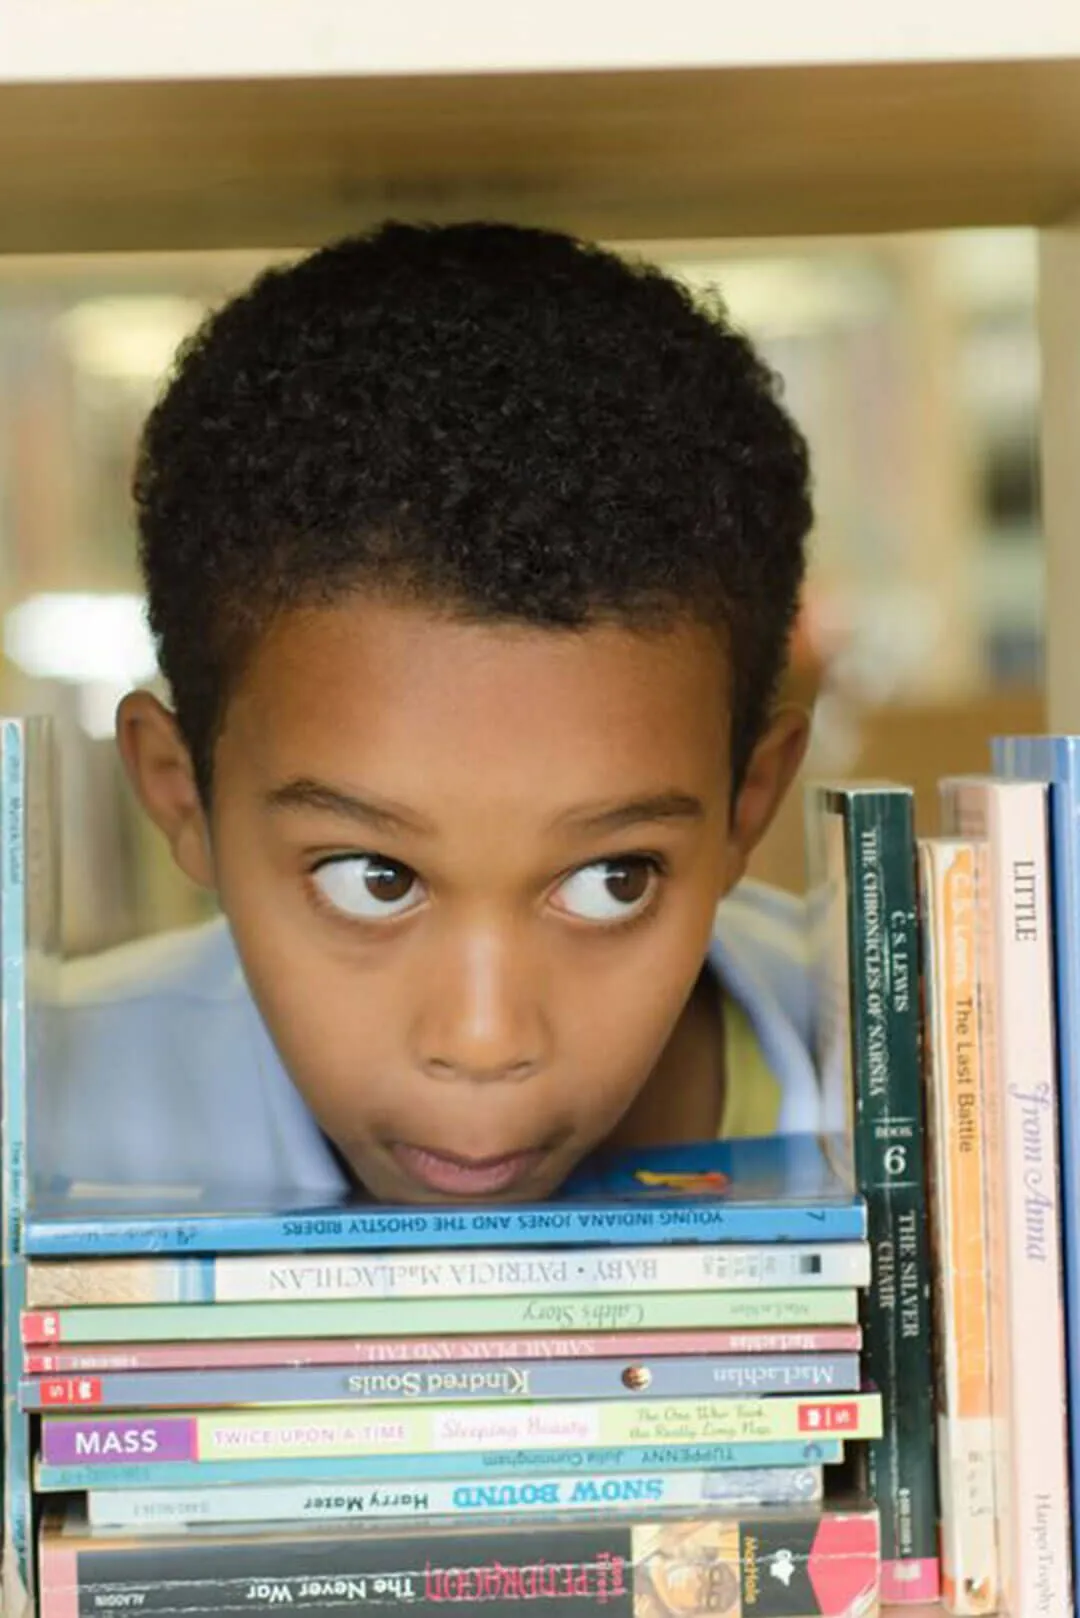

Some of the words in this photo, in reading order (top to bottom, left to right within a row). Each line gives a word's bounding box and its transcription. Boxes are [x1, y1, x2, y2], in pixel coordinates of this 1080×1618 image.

[861, 829, 878, 867] THE
[1013, 860, 1037, 941] LITTLE
[864, 872, 881, 991] CHRONICLES
[893, 951, 910, 1012] LEWIS
[866, 994, 882, 1018] OF
[956, 997, 973, 1034] The
[867, 1024, 886, 1097] NARNIA
[957, 1042, 976, 1084] Last
[957, 1094, 977, 1153] Battle
[884, 1145, 907, 1175] 6
[349, 1218, 428, 1234] GHOSTLY
[433, 1217, 467, 1232] THE
[472, 1216, 510, 1231] AND
[518, 1214, 571, 1230] JONES
[579, 1212, 653, 1228] INDIANA
[661, 1211, 723, 1227] YOUNG
[1023, 1168, 1053, 1262] Anna
[282, 1220, 343, 1236] RIDERS
[898, 1210, 916, 1257] THE
[269, 1265, 441, 1290] MacLACHLAN
[449, 1261, 567, 1285] PATRICIA
[595, 1259, 657, 1282] BABY
[878, 1240, 896, 1310] CHAIR
[900, 1261, 919, 1338] SILVER
[523, 1302, 573, 1328] Story
[348, 1371, 422, 1397] Souls
[427, 1368, 530, 1395] Kindred
[714, 1366, 835, 1387] MacLachlan
[75, 1429, 158, 1455] MASS
[214, 1430, 272, 1445] TWICE
[281, 1428, 335, 1443] UPON
[364, 1425, 406, 1440] TIME
[483, 1451, 583, 1469] Cunningham
[587, 1449, 624, 1466] Julia
[640, 1447, 736, 1464] TUPPENNY
[370, 1492, 429, 1511] Harry
[452, 1484, 560, 1509] BOUND
[572, 1478, 664, 1504] SNOW
[303, 1496, 364, 1512] Mazer
[246, 1584, 293, 1602] War
[299, 1579, 367, 1599] Never
[374, 1578, 416, 1597] The
[95, 1593, 146, 1607] ALADDIN
